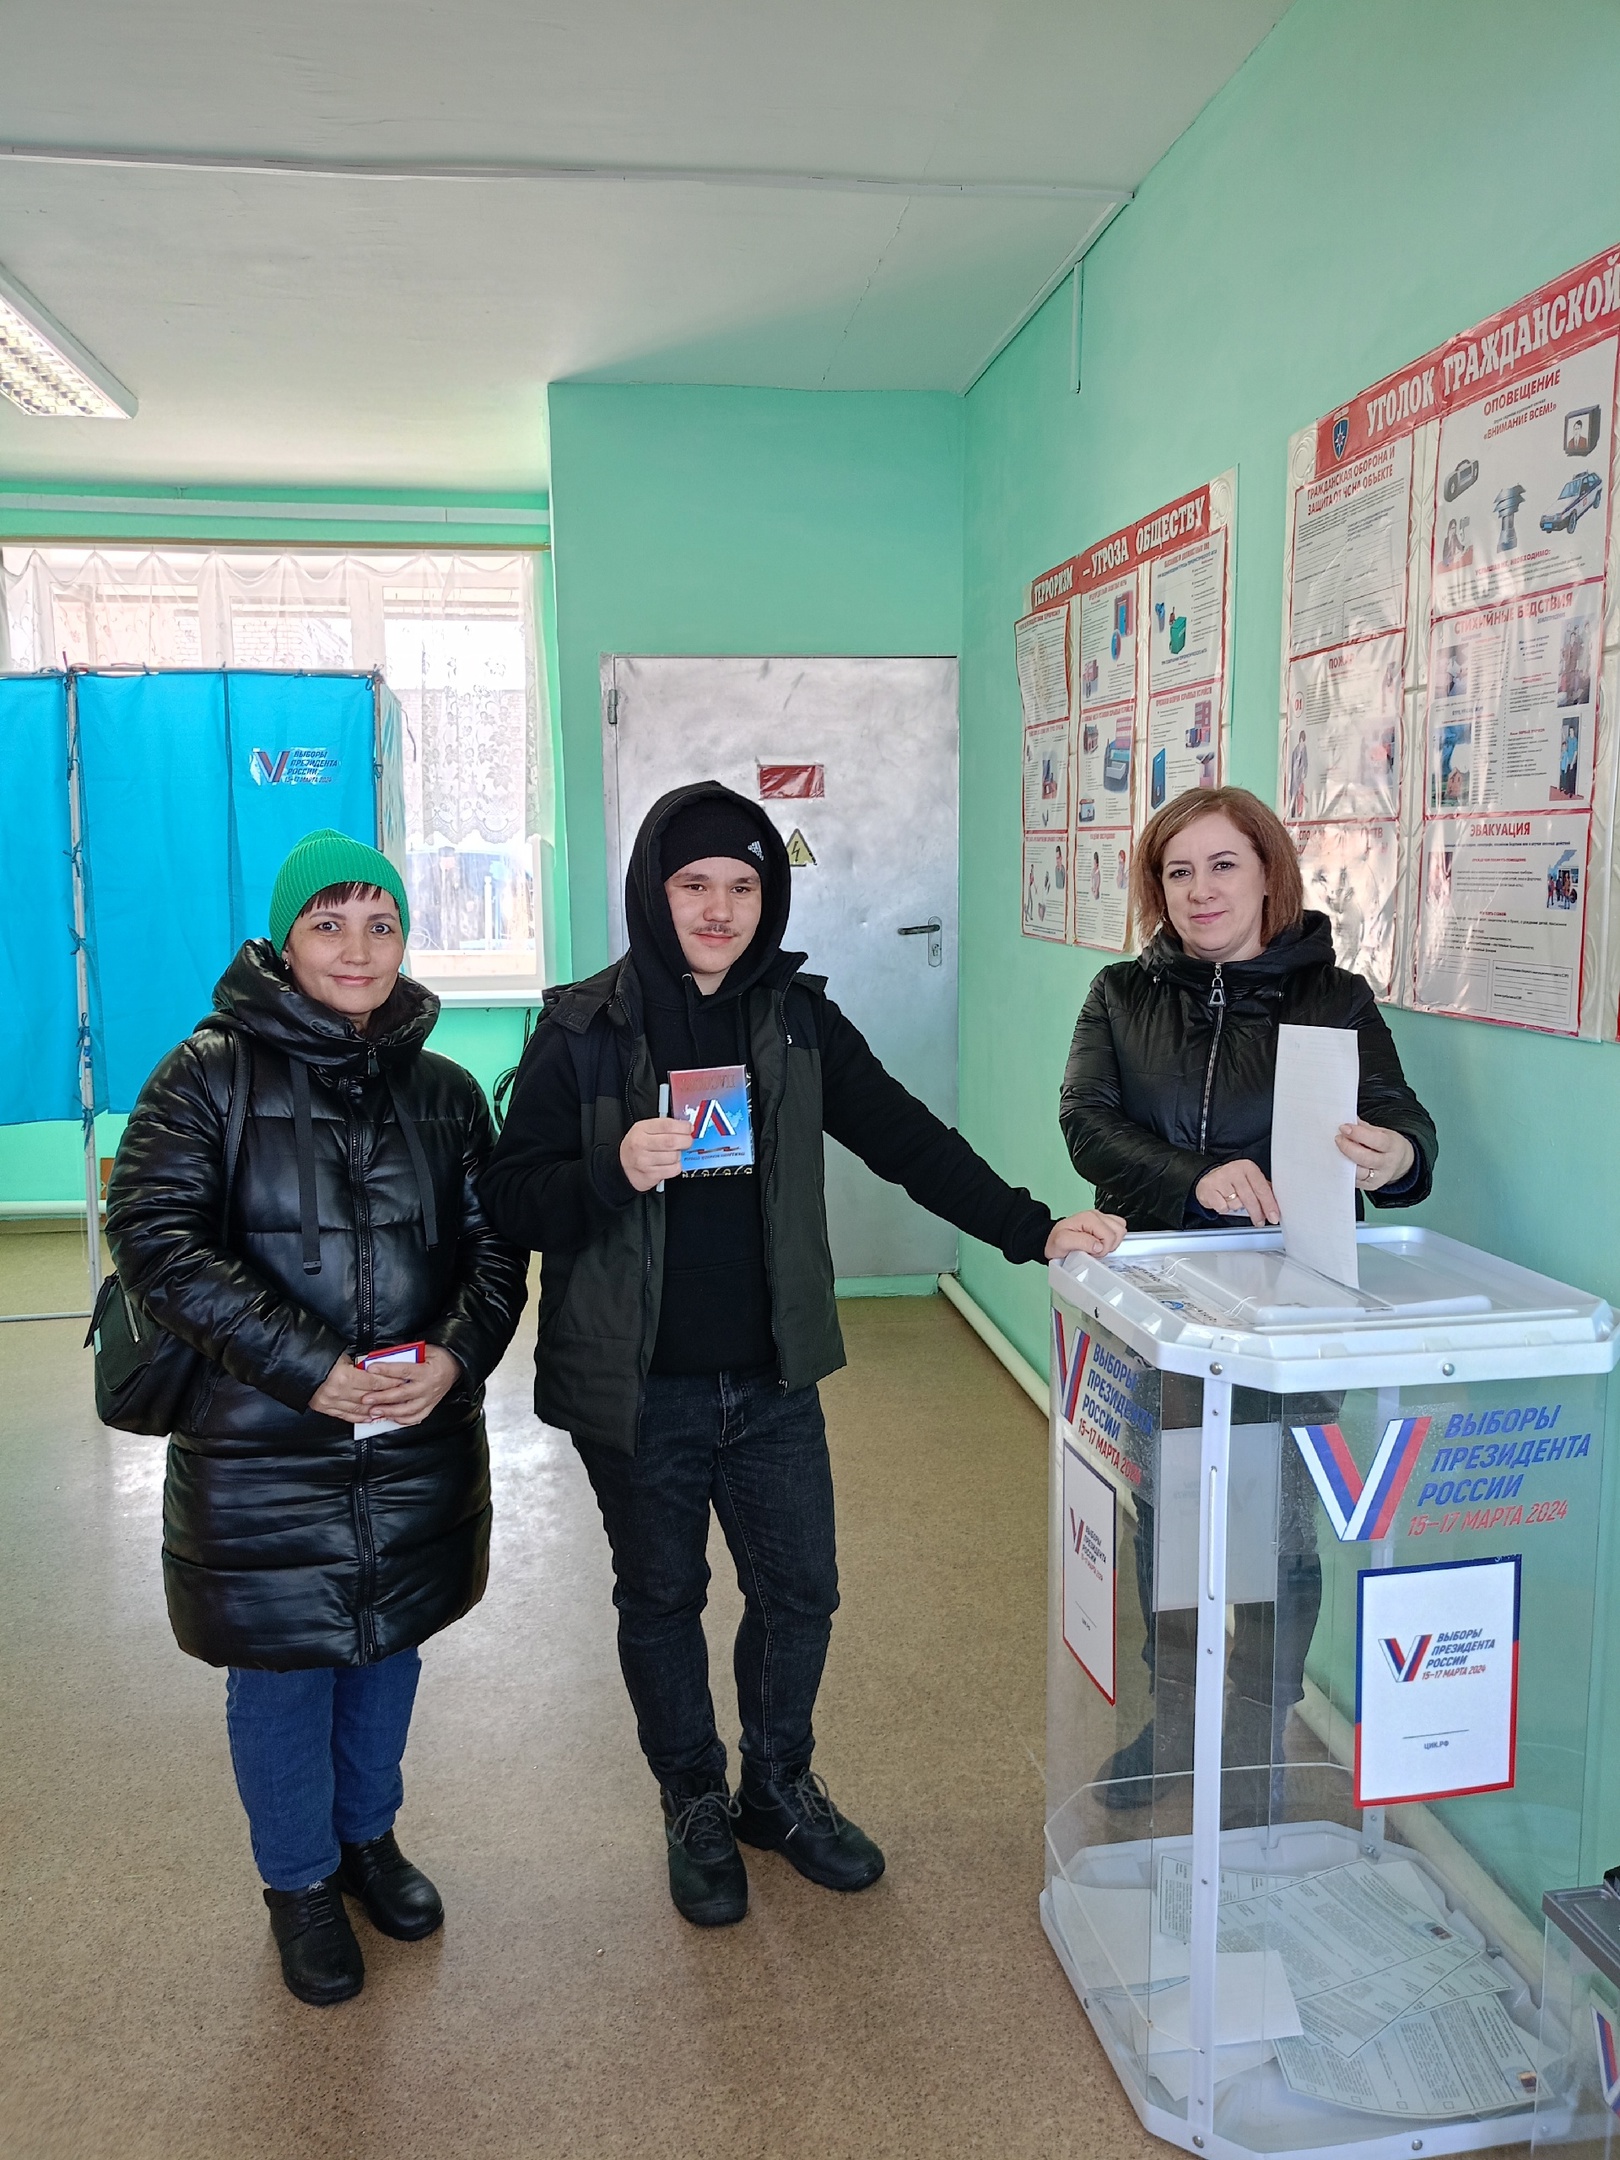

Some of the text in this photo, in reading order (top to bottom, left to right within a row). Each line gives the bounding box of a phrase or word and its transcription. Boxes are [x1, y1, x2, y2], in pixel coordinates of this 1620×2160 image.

[1366, 254, 1620, 437] УГОЛОК ГРАЖДАНСКОЙ
[1484, 369, 1560, 416] ОПОВЕЩЕНИЕ
[1308, 446, 1395, 500] ГРАЖДАНСКАЯ ОБОРОНА И
[1308, 495, 1333, 516] ЗАЩИТА
[1362, 464, 1393, 489] ОБЪЕКТЕ
[1034, 565, 1073, 607] ТЕРРОРИЗМ
[1091, 537, 1129, 579] УГРОЗА
[1135, 495, 1206, 555] ОБЩЕСТВУ
[1454, 608, 1513, 634] СТИХИЙНЫЕ
[1470, 822, 1530, 838] ЭВАКУАЦИЯ
[1093, 1343, 1138, 1391] ВЫБОРЫ
[1082, 1394, 1121, 1441] РОССИИ
[1087, 1369, 1153, 1436] ПРЕЗИДЕНТА
[1444, 1405, 1561, 1439] ВЫБОРЫ
[1096, 1434, 1120, 1471] МАРТА
[1120, 1456, 1142, 1486] 2024
[1430, 1433, 1591, 1473] ПРЕЗИДЕНТА
[1417, 1474, 1524, 1507] РОССИИ
[1460, 1507, 1523, 1530] МАРТА
[1525, 1499, 1568, 1525] 2024
[1431, 1639, 1495, 1656] ПРЕЗИДЕНТА
[1437, 1628, 1483, 1643] ВЫБОРЫ
[1426, 1655, 1468, 1669] РОССИИ
[1443, 1667, 1467, 1678] МАРТА
[1468, 1664, 1486, 1675] 2024
[1424, 1740, 1449, 1750] ЦИК.РФ
